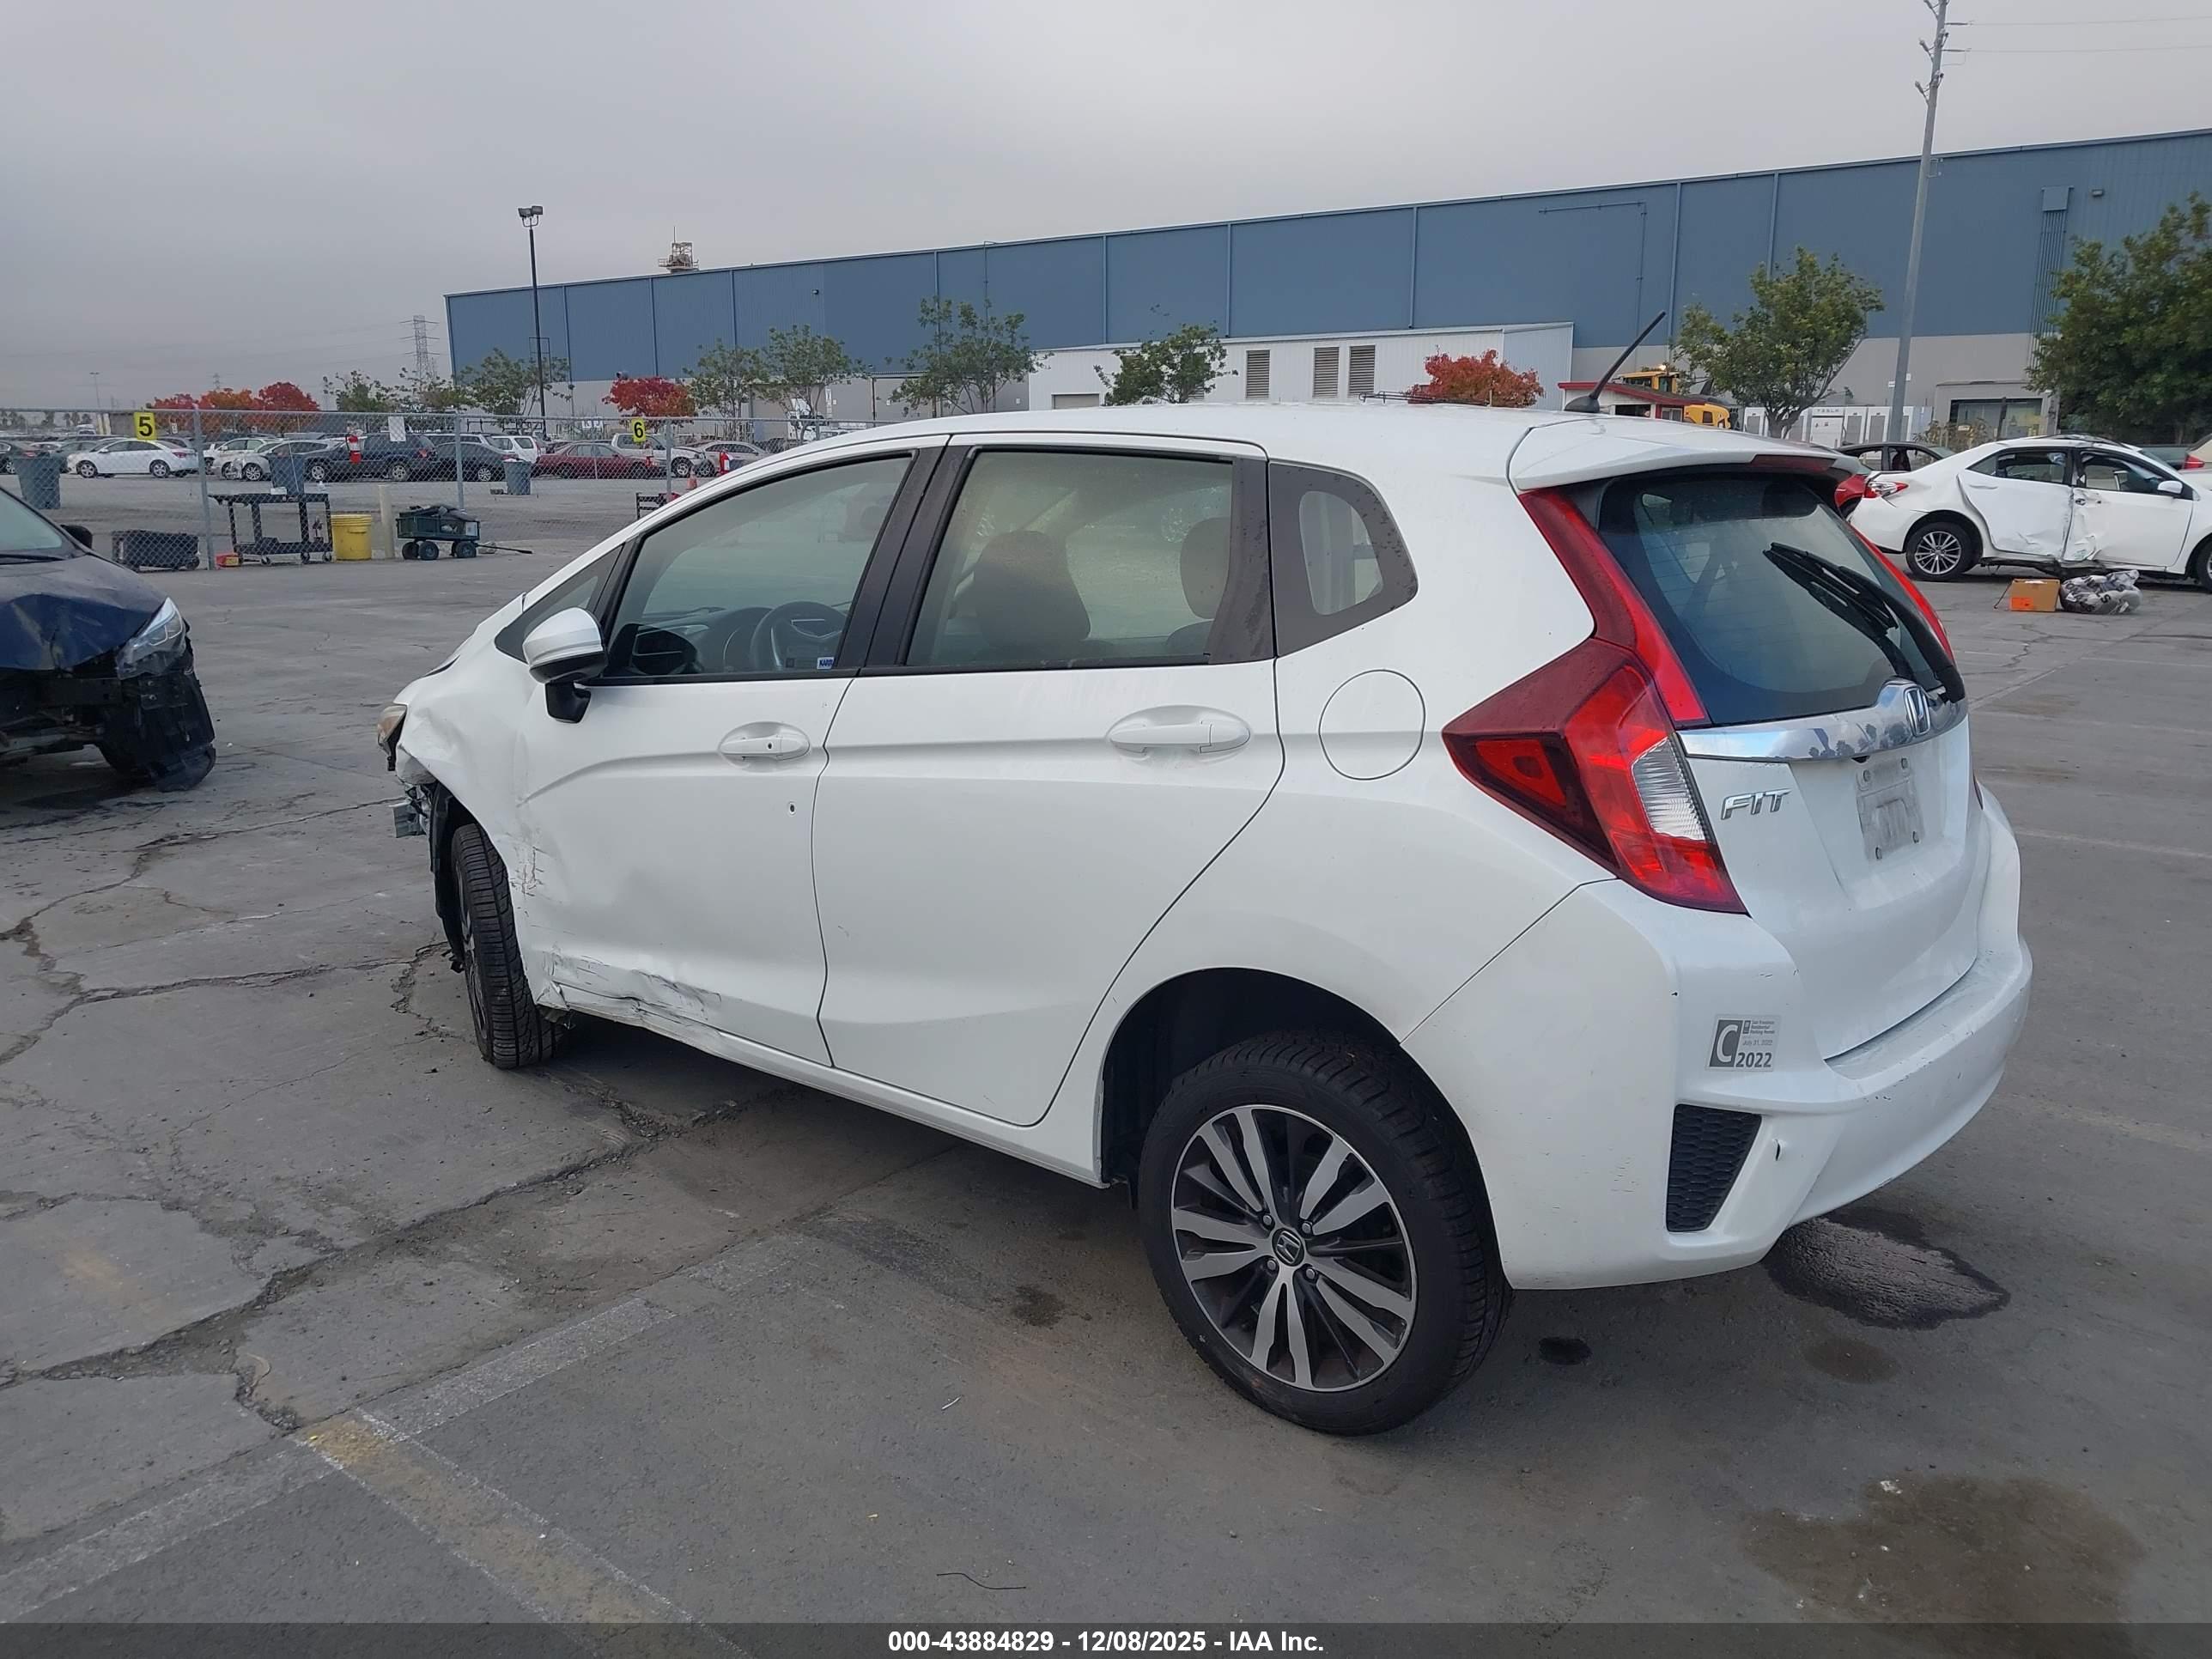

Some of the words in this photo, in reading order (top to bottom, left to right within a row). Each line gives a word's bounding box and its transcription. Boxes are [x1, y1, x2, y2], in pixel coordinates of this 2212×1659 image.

[139, 416, 153, 436] 5
[634, 422, 644, 439] 6
[1721, 787, 1792, 820] FIT
[1717, 1024, 1738, 1063] C
[1735, 1052, 1773, 1068] 2022
